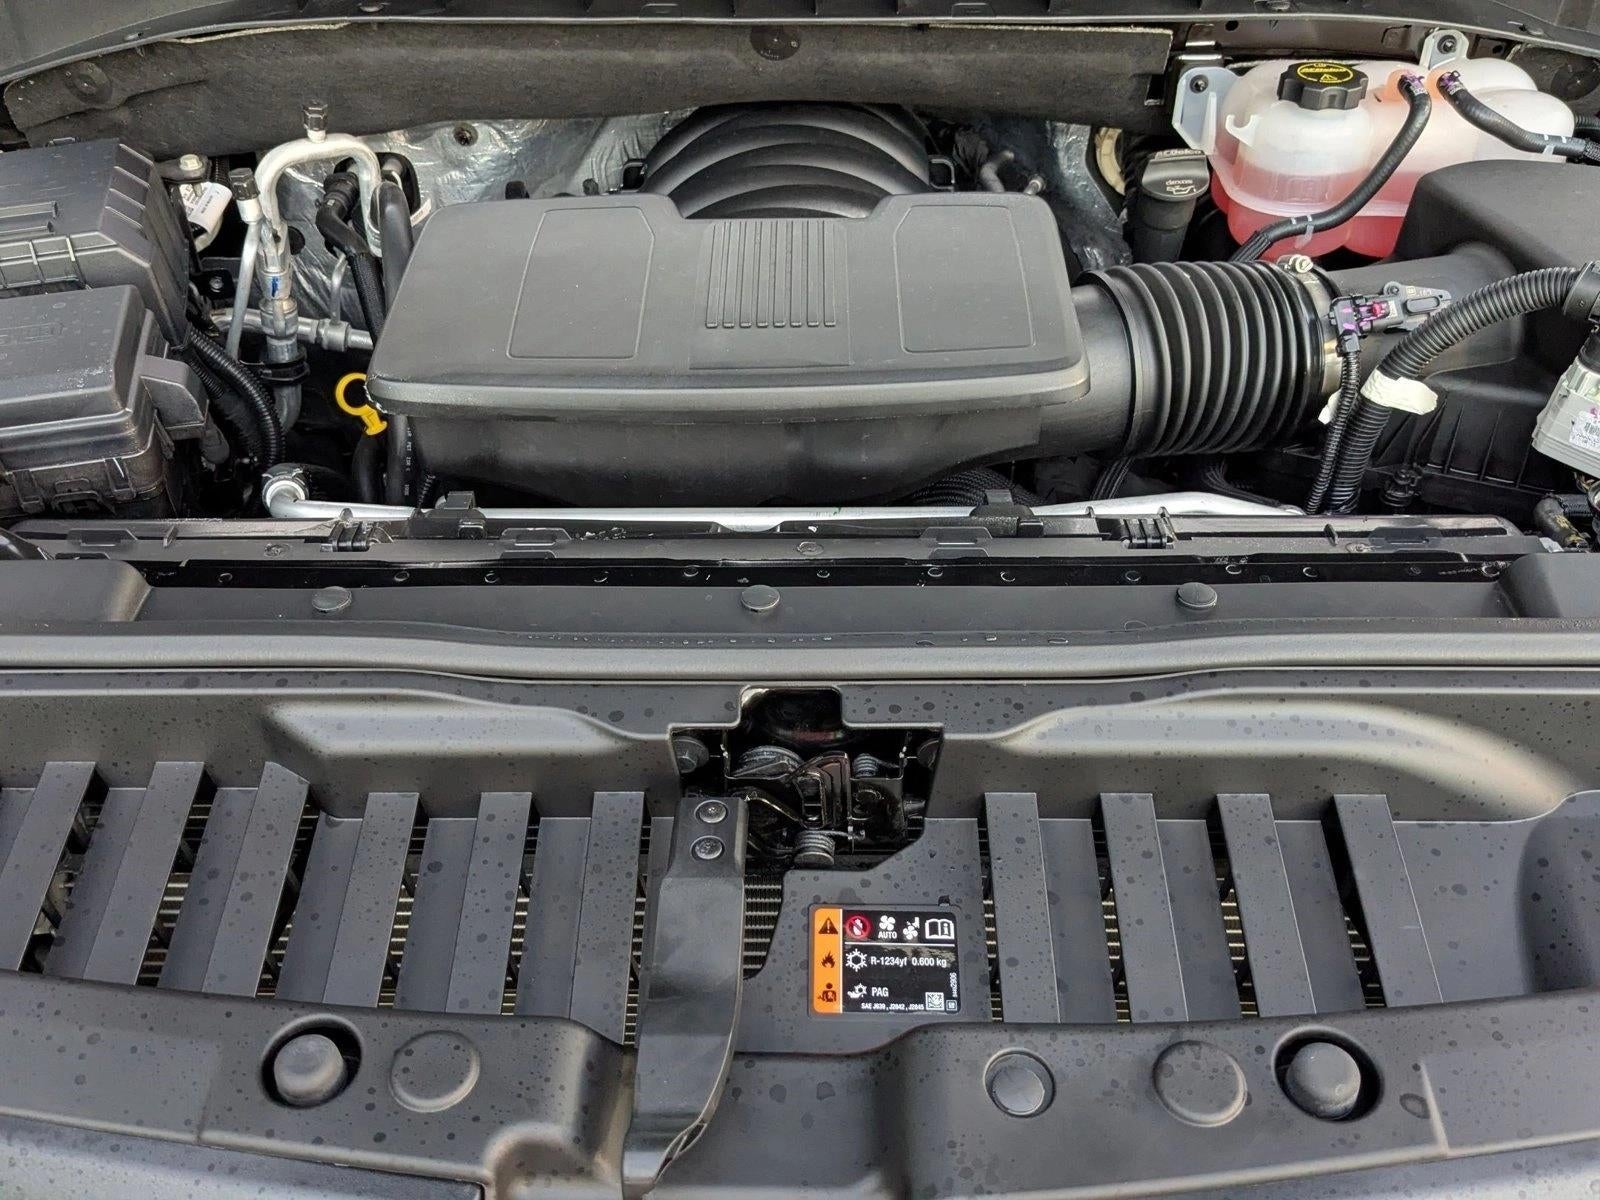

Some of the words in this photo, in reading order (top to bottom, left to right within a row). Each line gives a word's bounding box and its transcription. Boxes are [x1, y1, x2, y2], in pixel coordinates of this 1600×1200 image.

[878, 931, 897, 939] AUTO
[870, 956, 908, 968] R-1234yf
[911, 957, 935, 966] 0.600
[936, 957, 947, 968] kg
[871, 987, 889, 997] PAG
[861, 1002, 872, 1010] SAE
